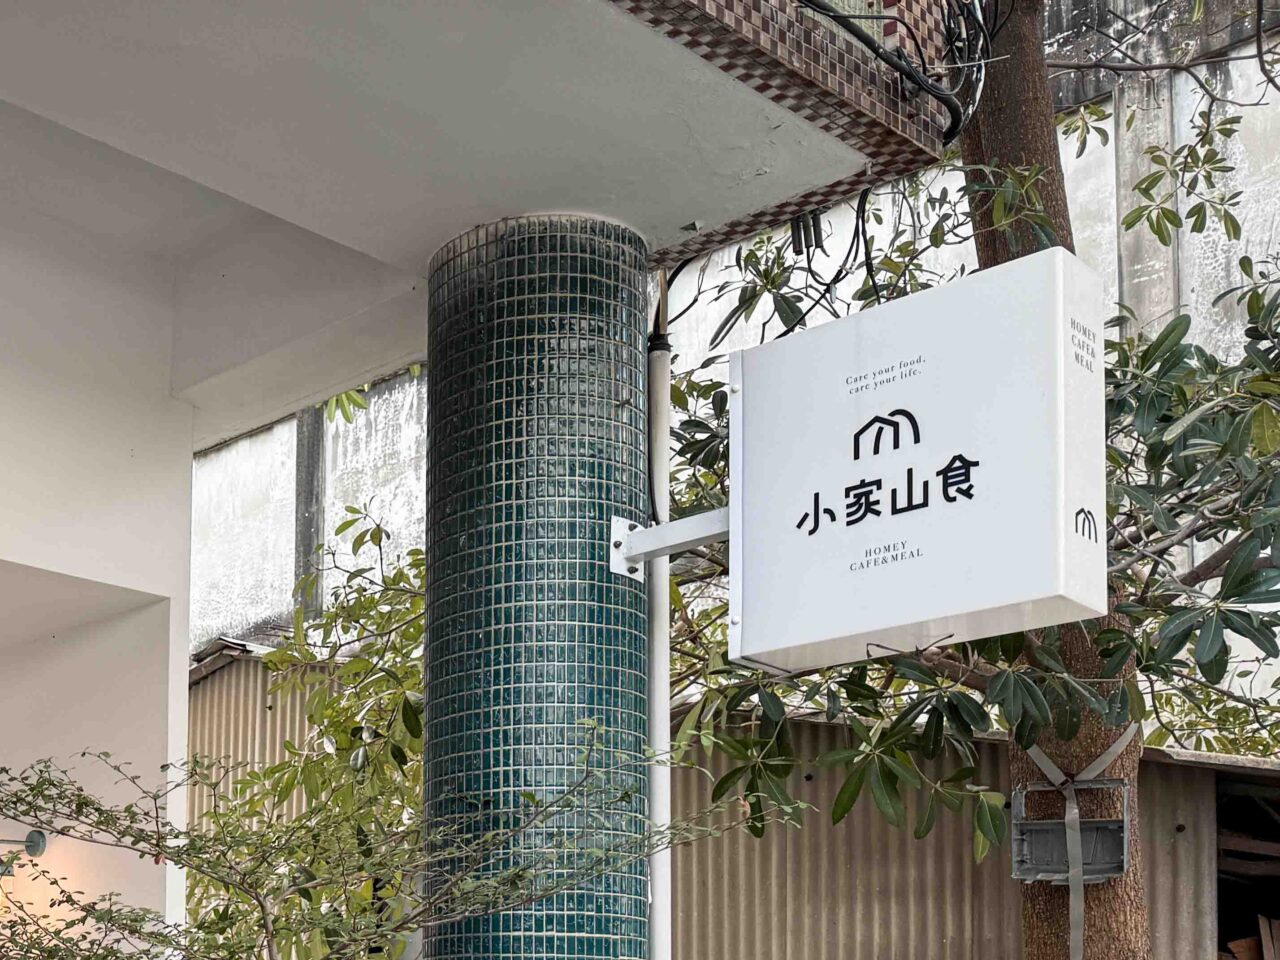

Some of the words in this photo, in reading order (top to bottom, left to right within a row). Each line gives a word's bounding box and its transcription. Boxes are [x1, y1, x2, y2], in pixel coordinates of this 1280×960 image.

[1070, 317, 1096, 344] HOMEY
[1071, 334, 1096, 359] CAFE&
[1074, 351, 1094, 373] MEAL
[845, 373, 869, 385] Care
[872, 365, 895, 380] your
[849, 383, 870, 395] care
[873, 375, 897, 390] your
[795, 453, 980, 537] 小家山食
[849, 548, 924, 571] CAFE&MEAL
[865, 540, 907, 558] HOMEY
